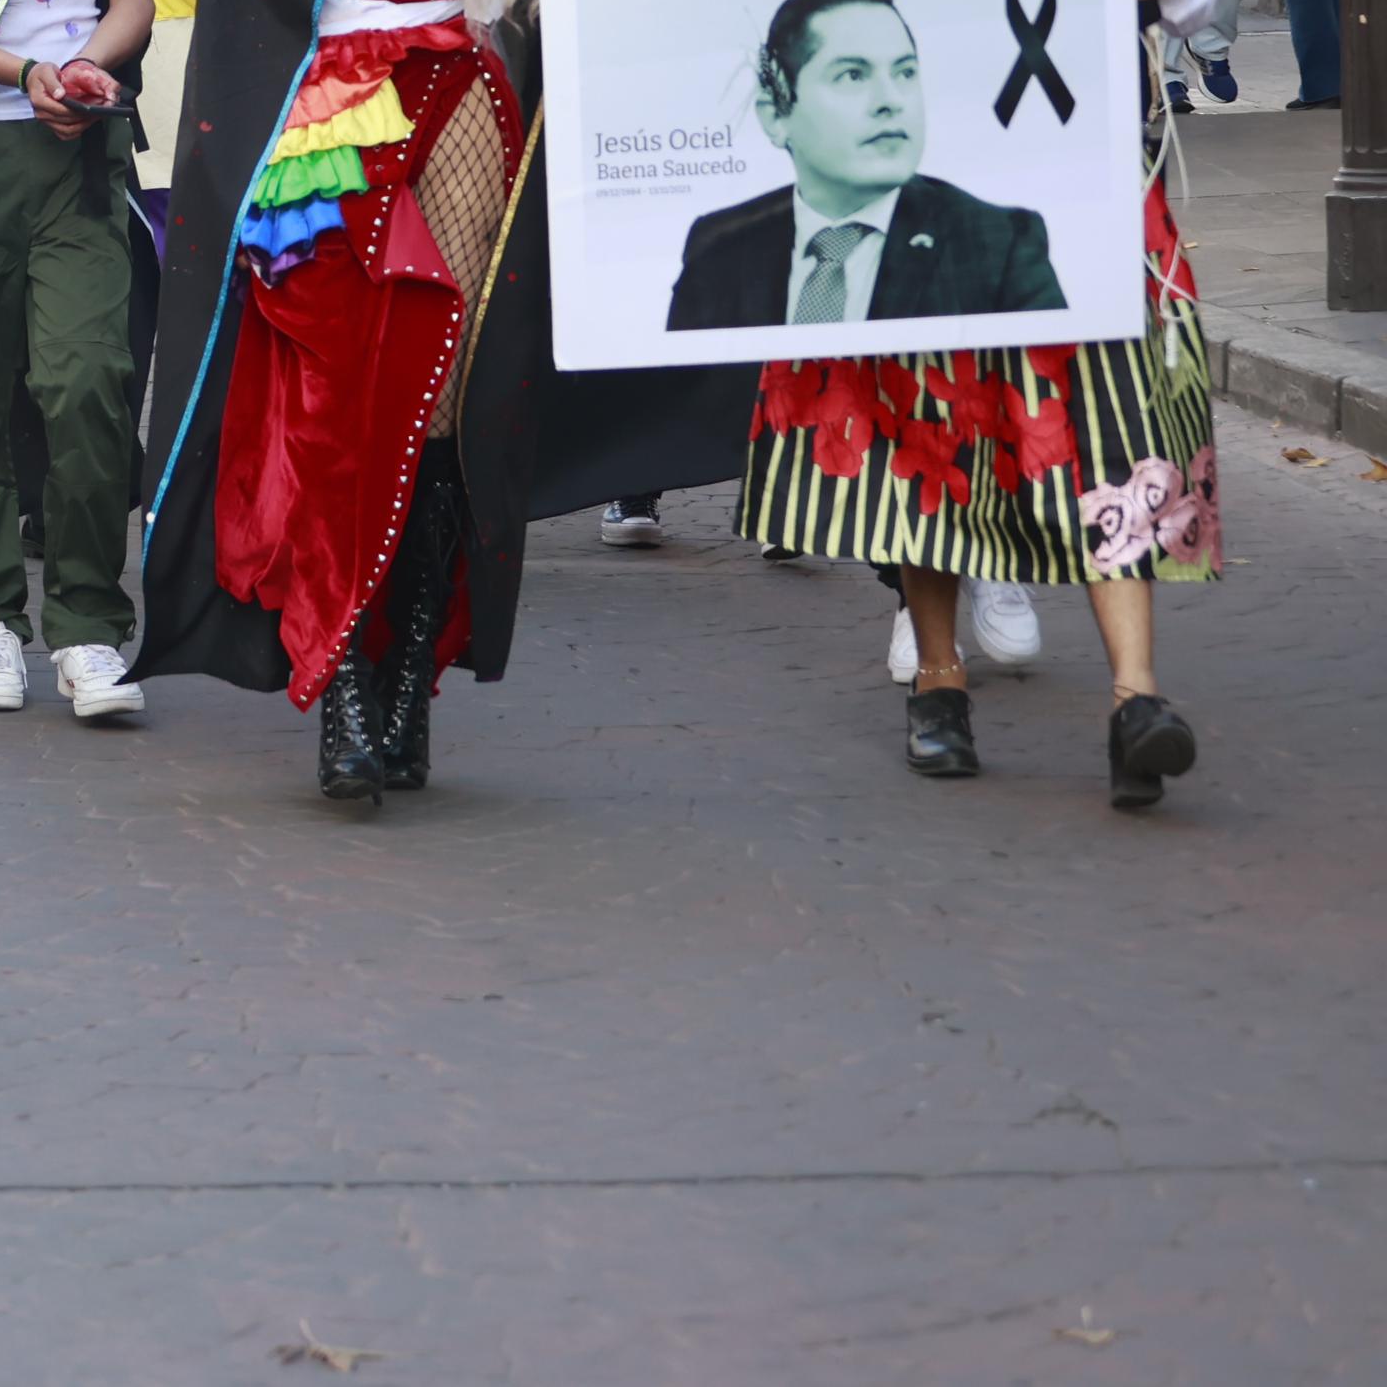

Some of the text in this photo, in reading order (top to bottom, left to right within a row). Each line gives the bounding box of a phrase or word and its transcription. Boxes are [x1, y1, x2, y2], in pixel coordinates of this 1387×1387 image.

[594, 125, 733, 158] Jesús Ociel
[596, 156, 747, 181] Baena Saucedo
